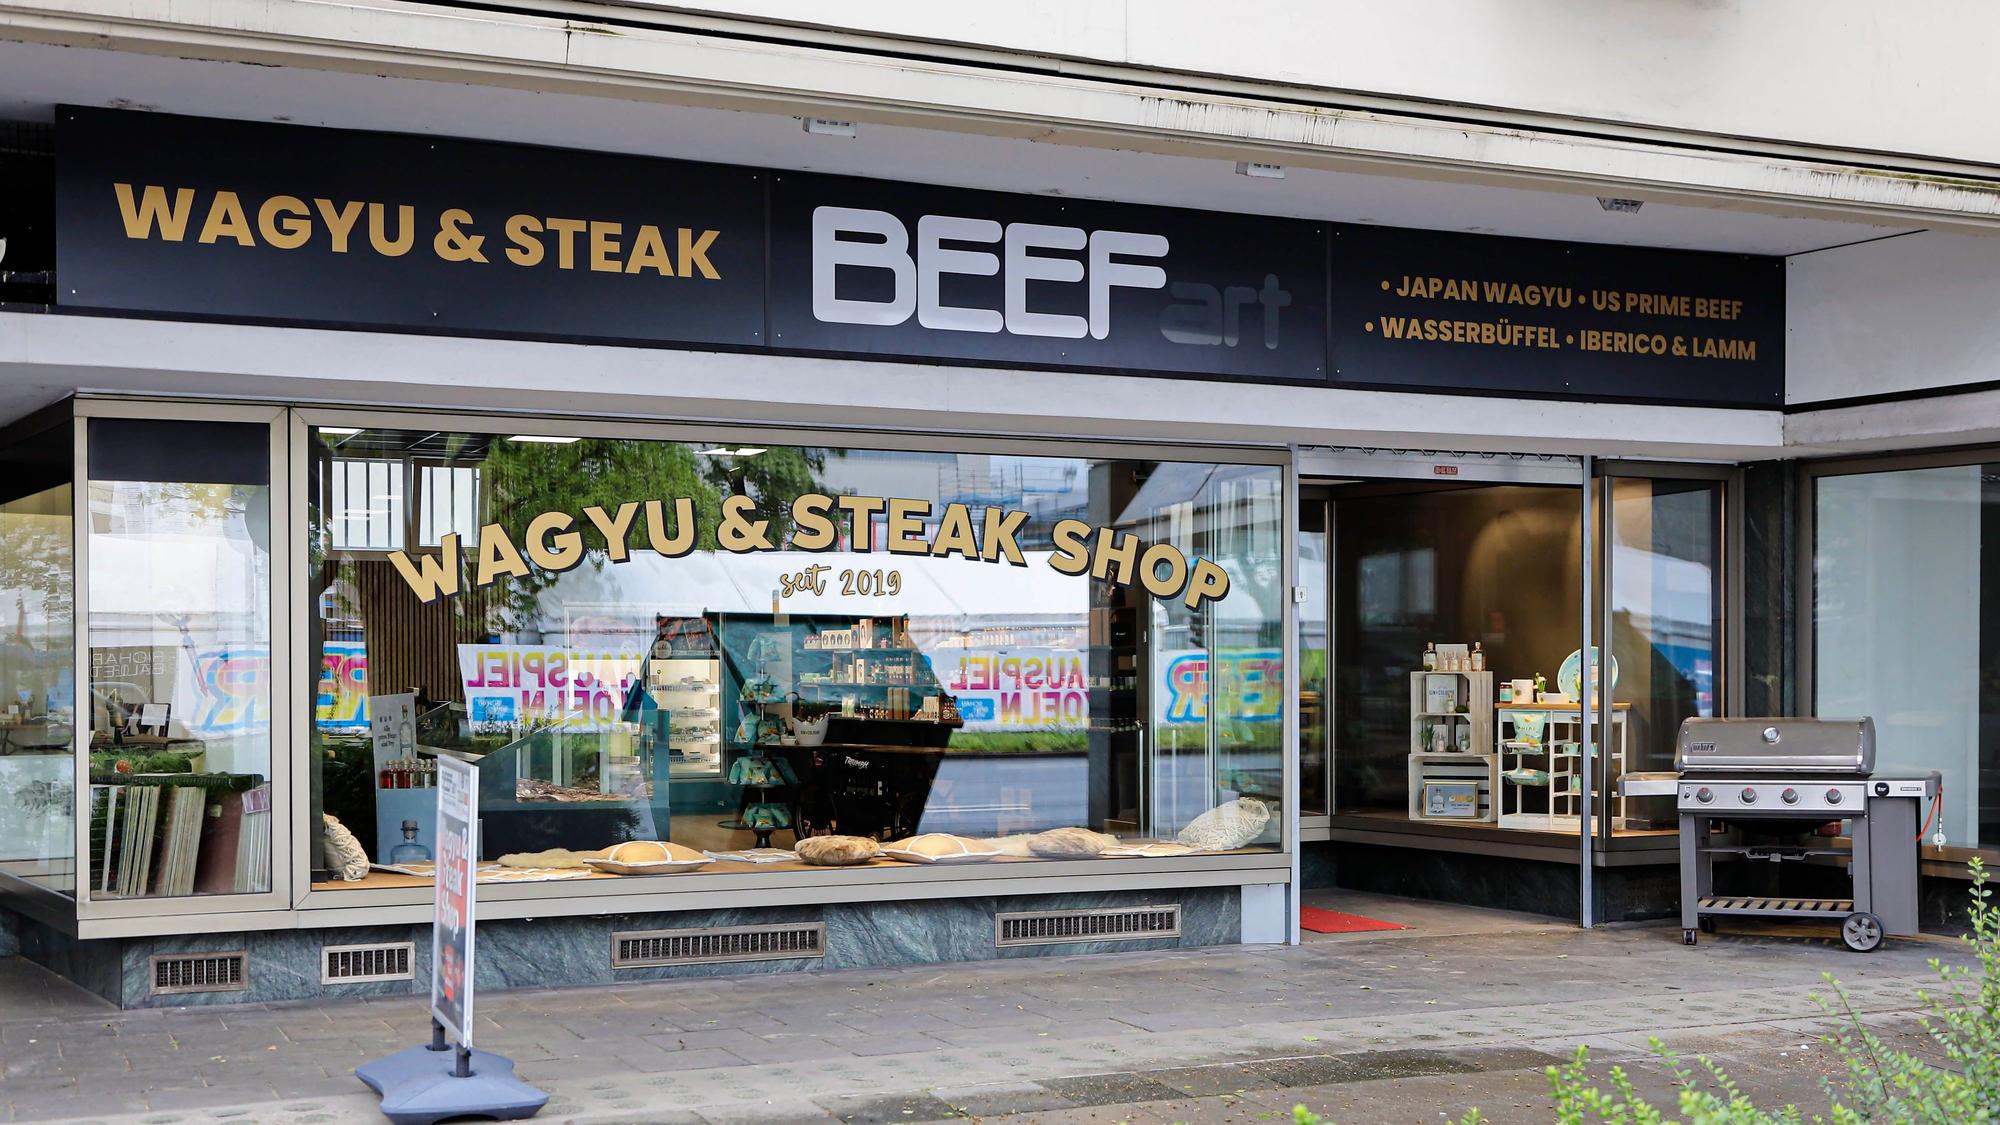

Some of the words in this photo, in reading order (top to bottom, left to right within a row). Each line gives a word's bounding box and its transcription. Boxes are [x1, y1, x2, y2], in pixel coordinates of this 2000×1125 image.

[113, 183, 415, 256] WAGYU
[434, 208, 489, 263] &
[505, 214, 721, 280] STEAK
[812, 205, 1170, 341] BEEF
[1159, 273, 1292, 350] art
[1397, 276, 1478, 301] JAPAN
[1483, 282, 1572, 308] WAGYU
[1592, 290, 1621, 312] US
[1625, 294, 1690, 317] PRIME
[1695, 298, 1742, 320] BEEF
[1381, 317, 1560, 349] WASSERBÜFFEL
[1580, 331, 1667, 355] IBERICO
[1672, 335, 1688, 356] &
[1692, 338, 1756, 360] LAMM
[387, 497, 697, 605] WAGYU
[717, 494, 775, 553] &
[791, 493, 1030, 568] STEAK
[1047, 518, 1231, 610] SHOP
[779, 564, 832, 599] seit
[839, 568, 902, 597] 2019
